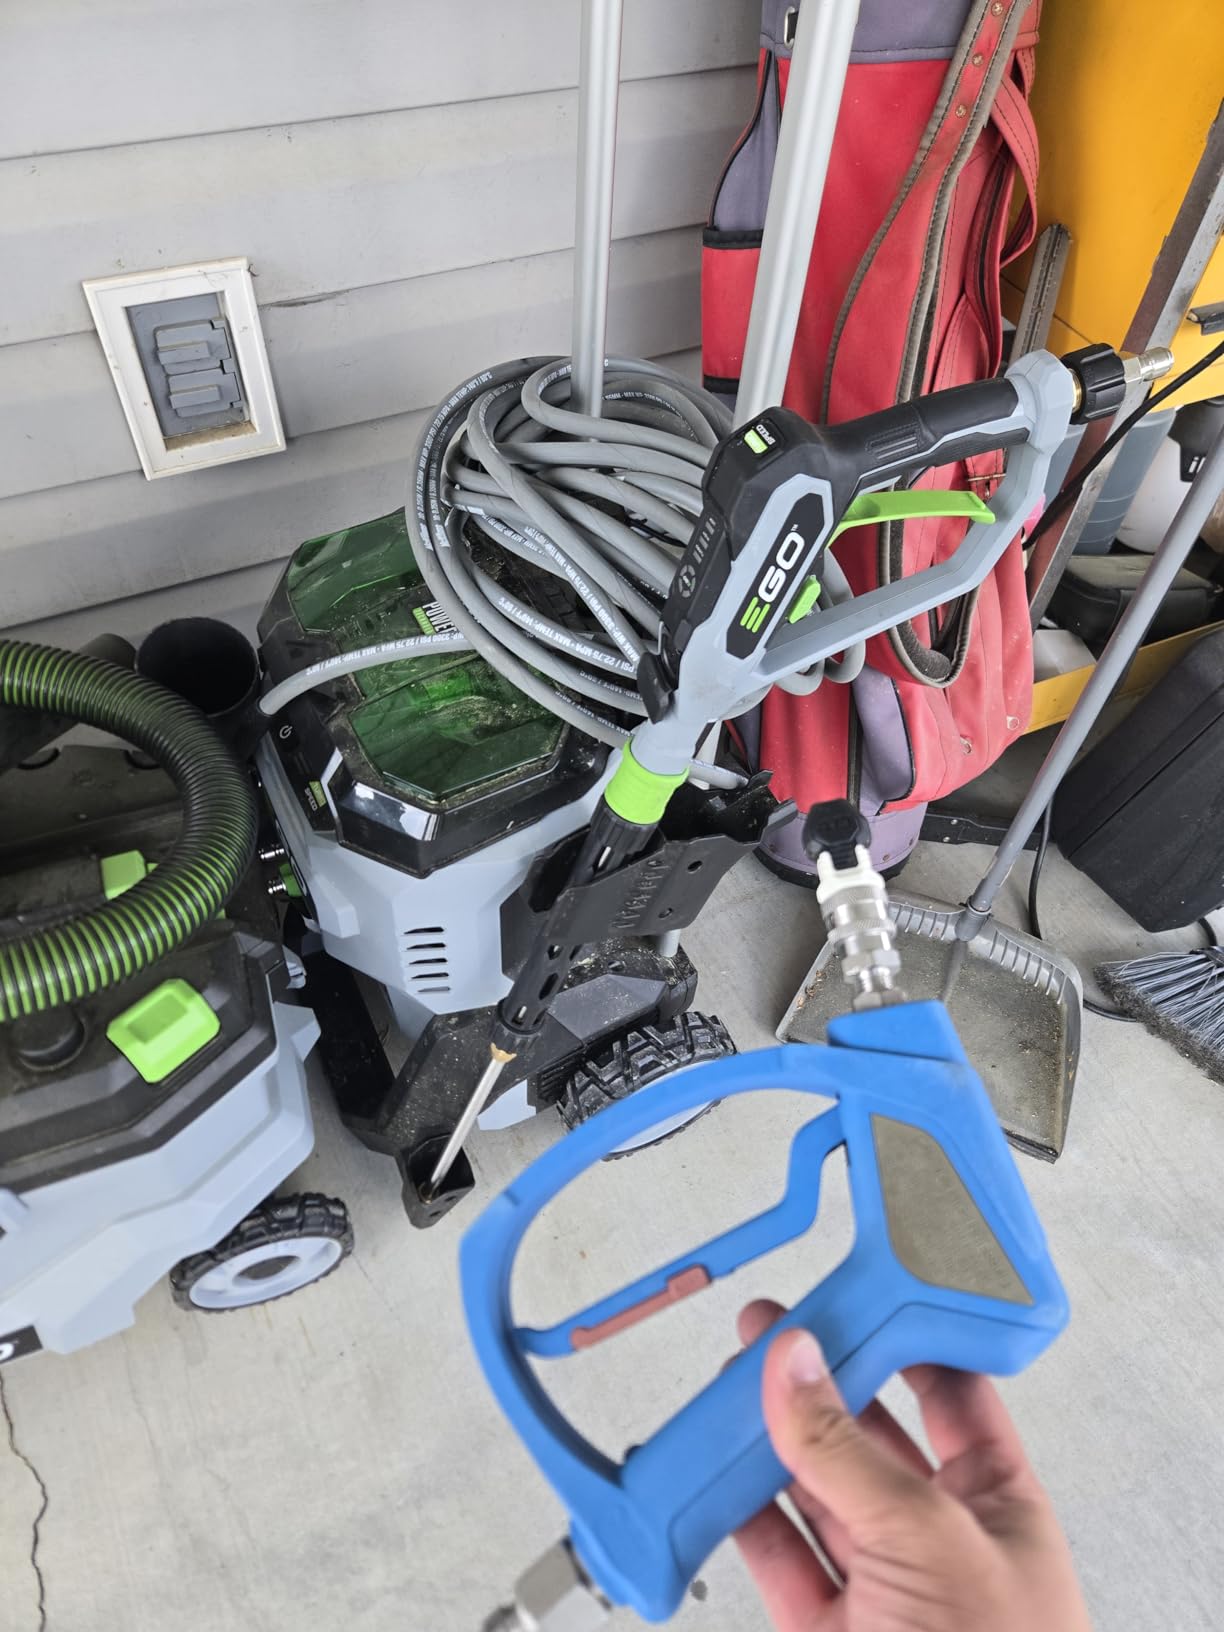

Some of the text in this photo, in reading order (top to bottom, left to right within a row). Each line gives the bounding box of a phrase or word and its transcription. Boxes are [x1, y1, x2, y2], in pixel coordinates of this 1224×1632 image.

[755, 424, 776, 446] SPEED
[563, 564, 577, 578] MPA
[573, 576, 590, 595] 22.75
[588, 597, 602, 611] PSI
[514, 609, 534, 625] 140°F
[596, 608, 615, 630] 3300
[532, 620, 554, 638] TEMP:
[611, 627, 627, 644] WP:
[396, 638, 413, 648] 22.75
[420, 635, 431, 643] PSI
[553, 632, 570, 646] MAX
[361, 646, 376, 657] MAX
[381, 642, 394, 651] MPA
[575, 643, 593, 656] MPA
[623, 642, 639, 661] MAX
[592, 650, 615, 665] 22.75
[619, 661, 634, 672] PSI
